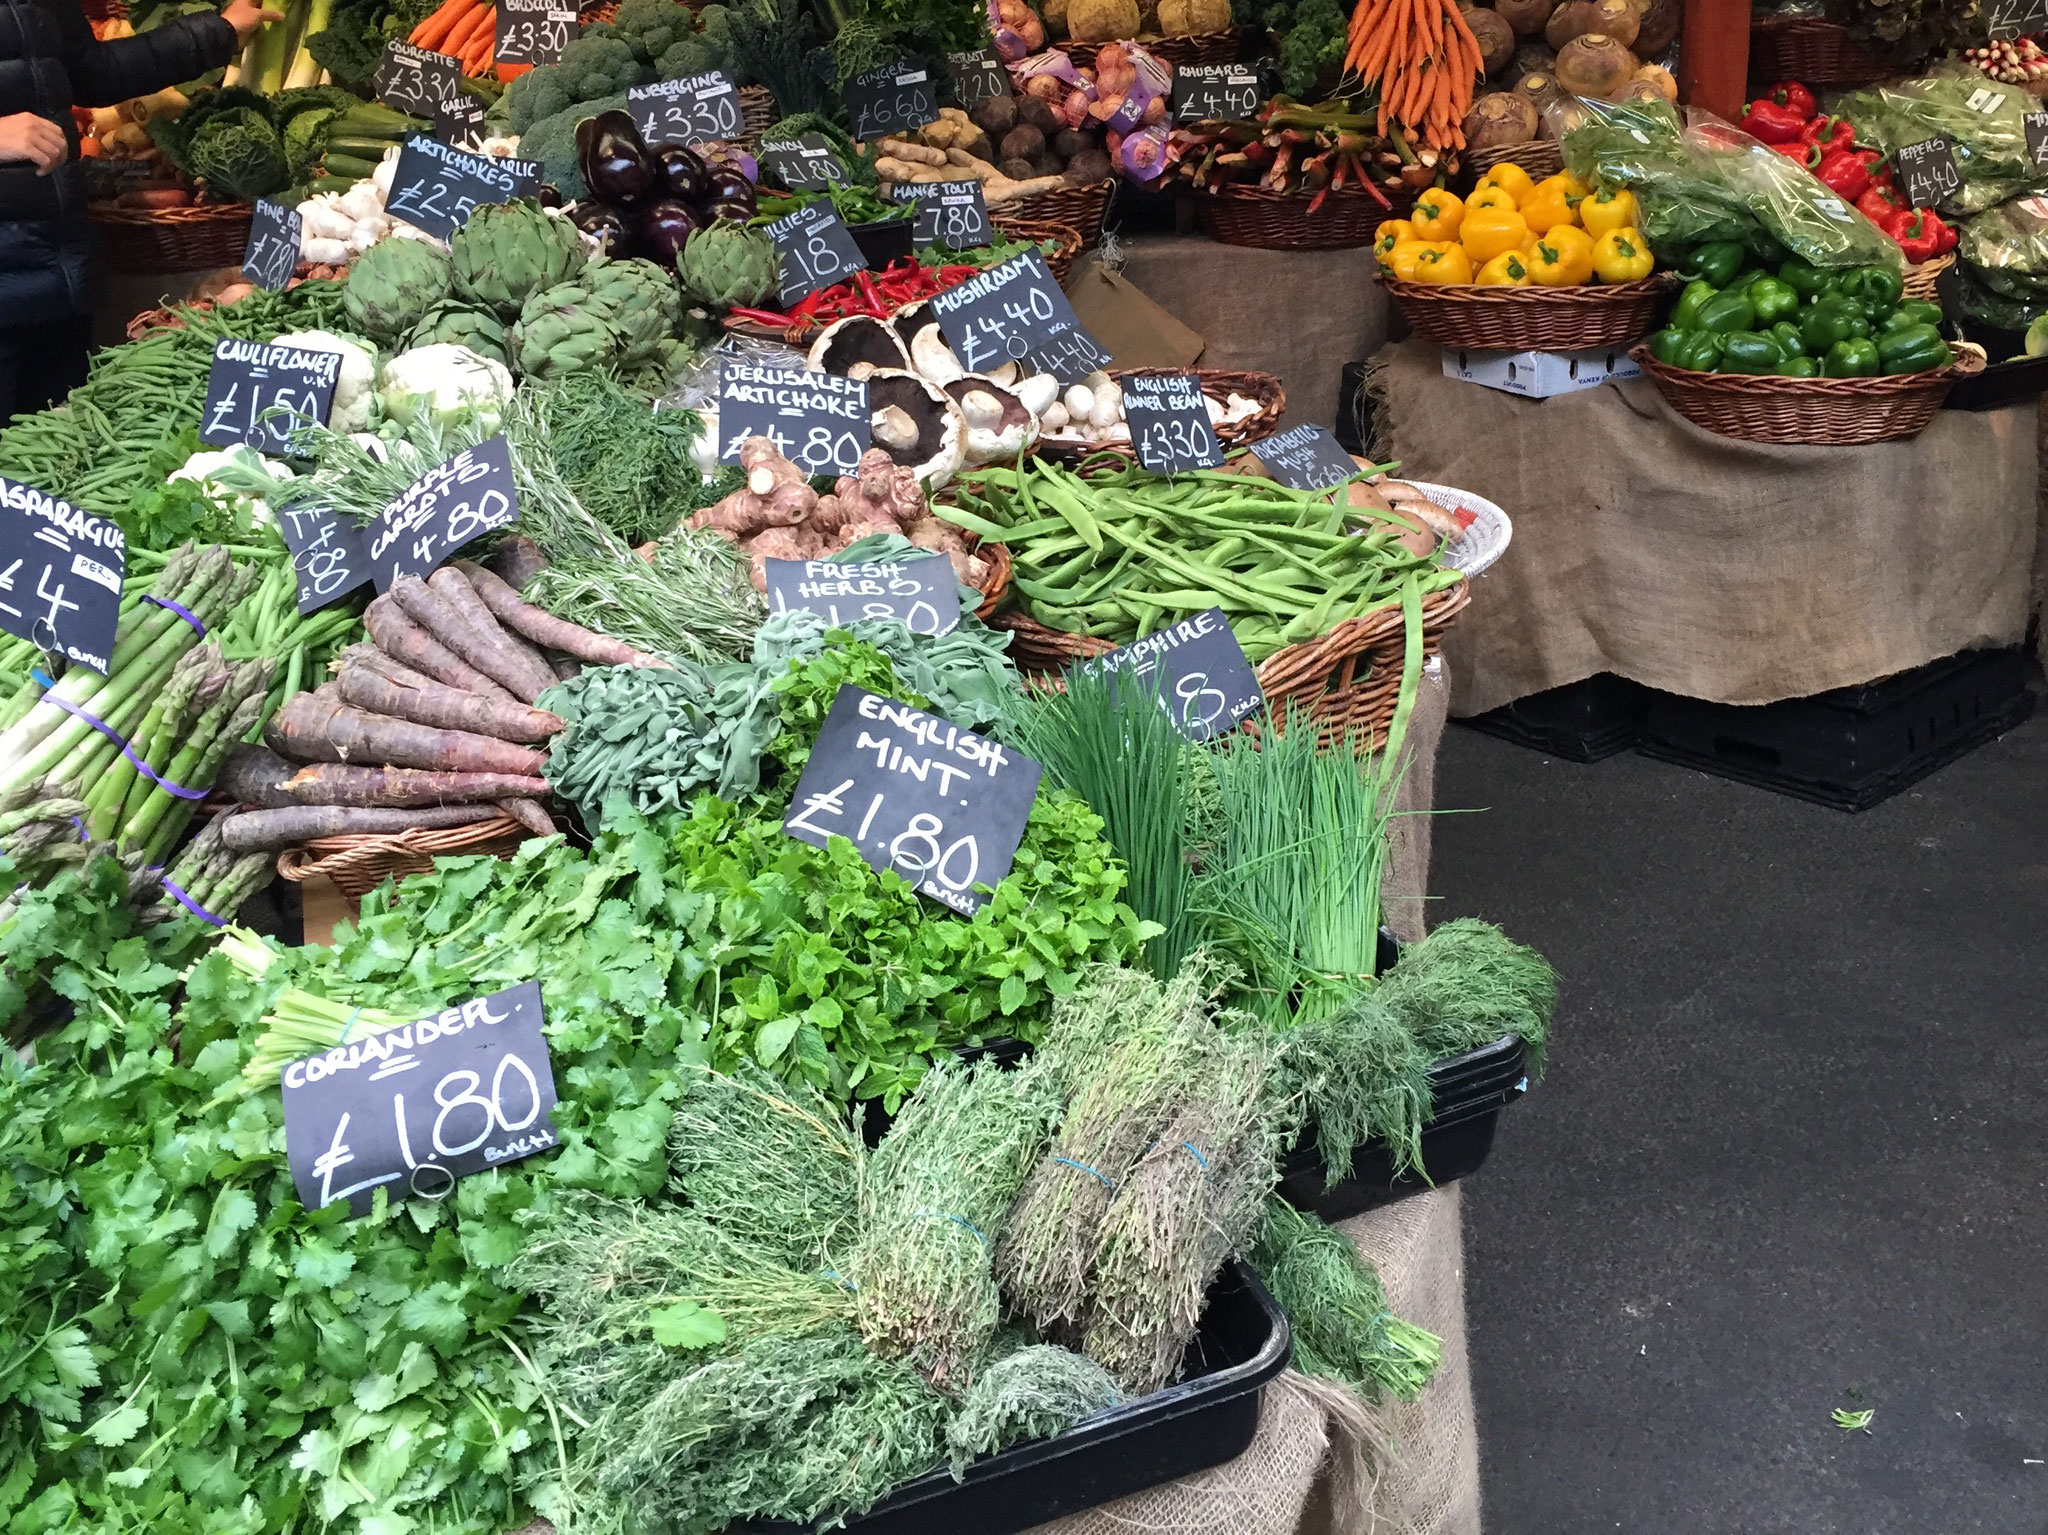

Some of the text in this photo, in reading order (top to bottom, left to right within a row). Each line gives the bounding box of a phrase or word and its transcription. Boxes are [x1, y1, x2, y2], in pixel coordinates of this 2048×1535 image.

[496, 21, 568, 58] £3.30
[384, 68, 457, 102] £3.30
[628, 71, 727, 101] AUBERGINE
[856, 61, 914, 88] GINGER
[1179, 64, 1248, 78] RHUBARB
[641, 97, 737, 143] £3.30
[779, 159, 841, 185] £1.80
[256, 199, 285, 225] FINE
[962, 287, 1054, 372] £4.40
[216, 340, 340, 384] CAULIFLOWER
[724, 364, 866, 408] JERUSALEM
[1123, 390, 1204, 411] RUNNER BEAN
[1133, 376, 1192, 395] ENGLISH
[1141, 419, 1210, 467] £3.30
[1276, 447, 1317, 471] MUSH
[383, 450, 474, 525] PURPLE
[805, 561, 908, 581] FRESH
[858, 694, 1009, 777] ENGLISH
[786, 779, 979, 891] £1.80
[312, 1053, 541, 1209] £1.80
